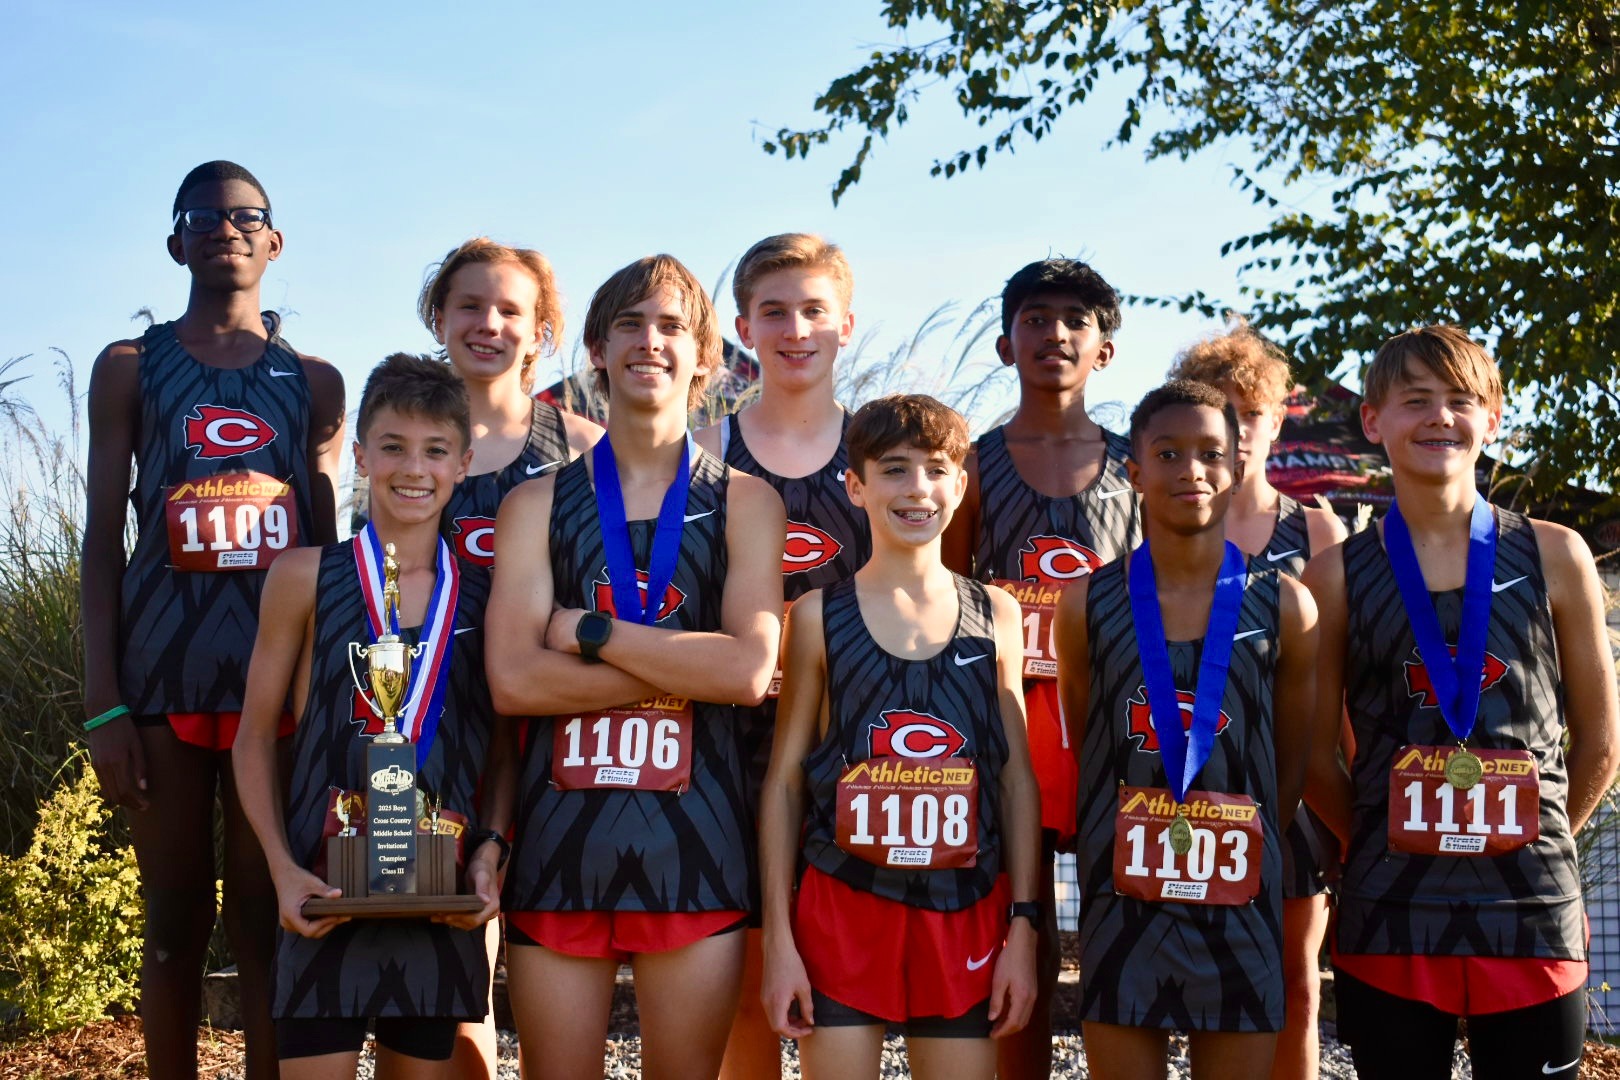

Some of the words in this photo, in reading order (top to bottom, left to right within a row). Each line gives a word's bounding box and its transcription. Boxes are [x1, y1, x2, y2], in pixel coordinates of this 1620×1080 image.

[180, 504, 288, 552] 1109
[564, 717, 680, 770] 1106
[946, 772, 970, 782] NET
[1501, 761, 1528, 772] NET
[850, 794, 968, 846] 1108
[1224, 808, 1252, 818] NET
[1404, 781, 1523, 835] 1111
[1125, 824, 1248, 882] 1103
[1168, 882, 1203, 890] Pirate
[1174, 890, 1202, 898] Timing
